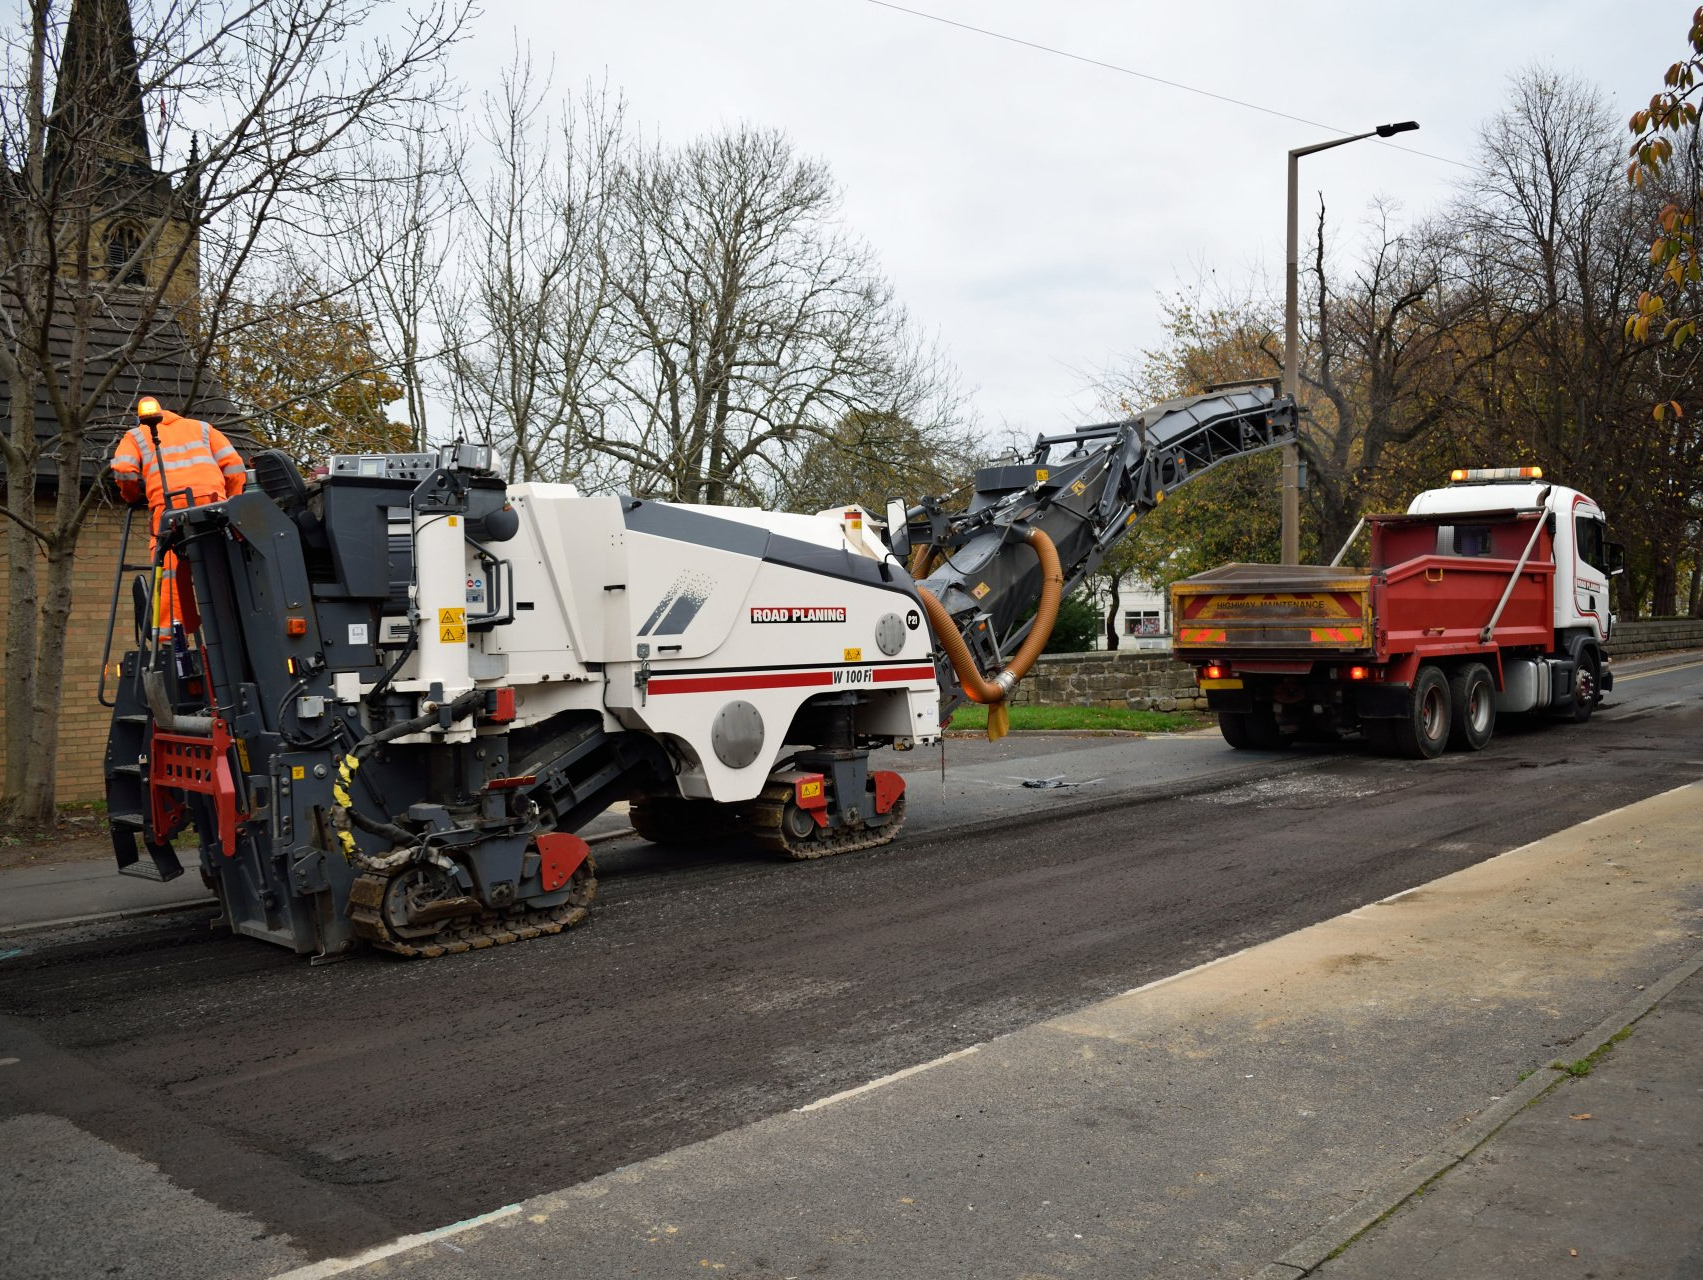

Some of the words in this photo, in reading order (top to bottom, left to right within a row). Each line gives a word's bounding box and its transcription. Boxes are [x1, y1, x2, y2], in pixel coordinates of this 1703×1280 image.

[1216, 601, 1256, 610] HIGHWAY
[1260, 600, 1325, 609] MAINTENANCE
[753, 609, 789, 622] ROAD
[792, 608, 845, 622] PLANING
[907, 615, 918, 625] P21
[833, 670, 843, 684] W
